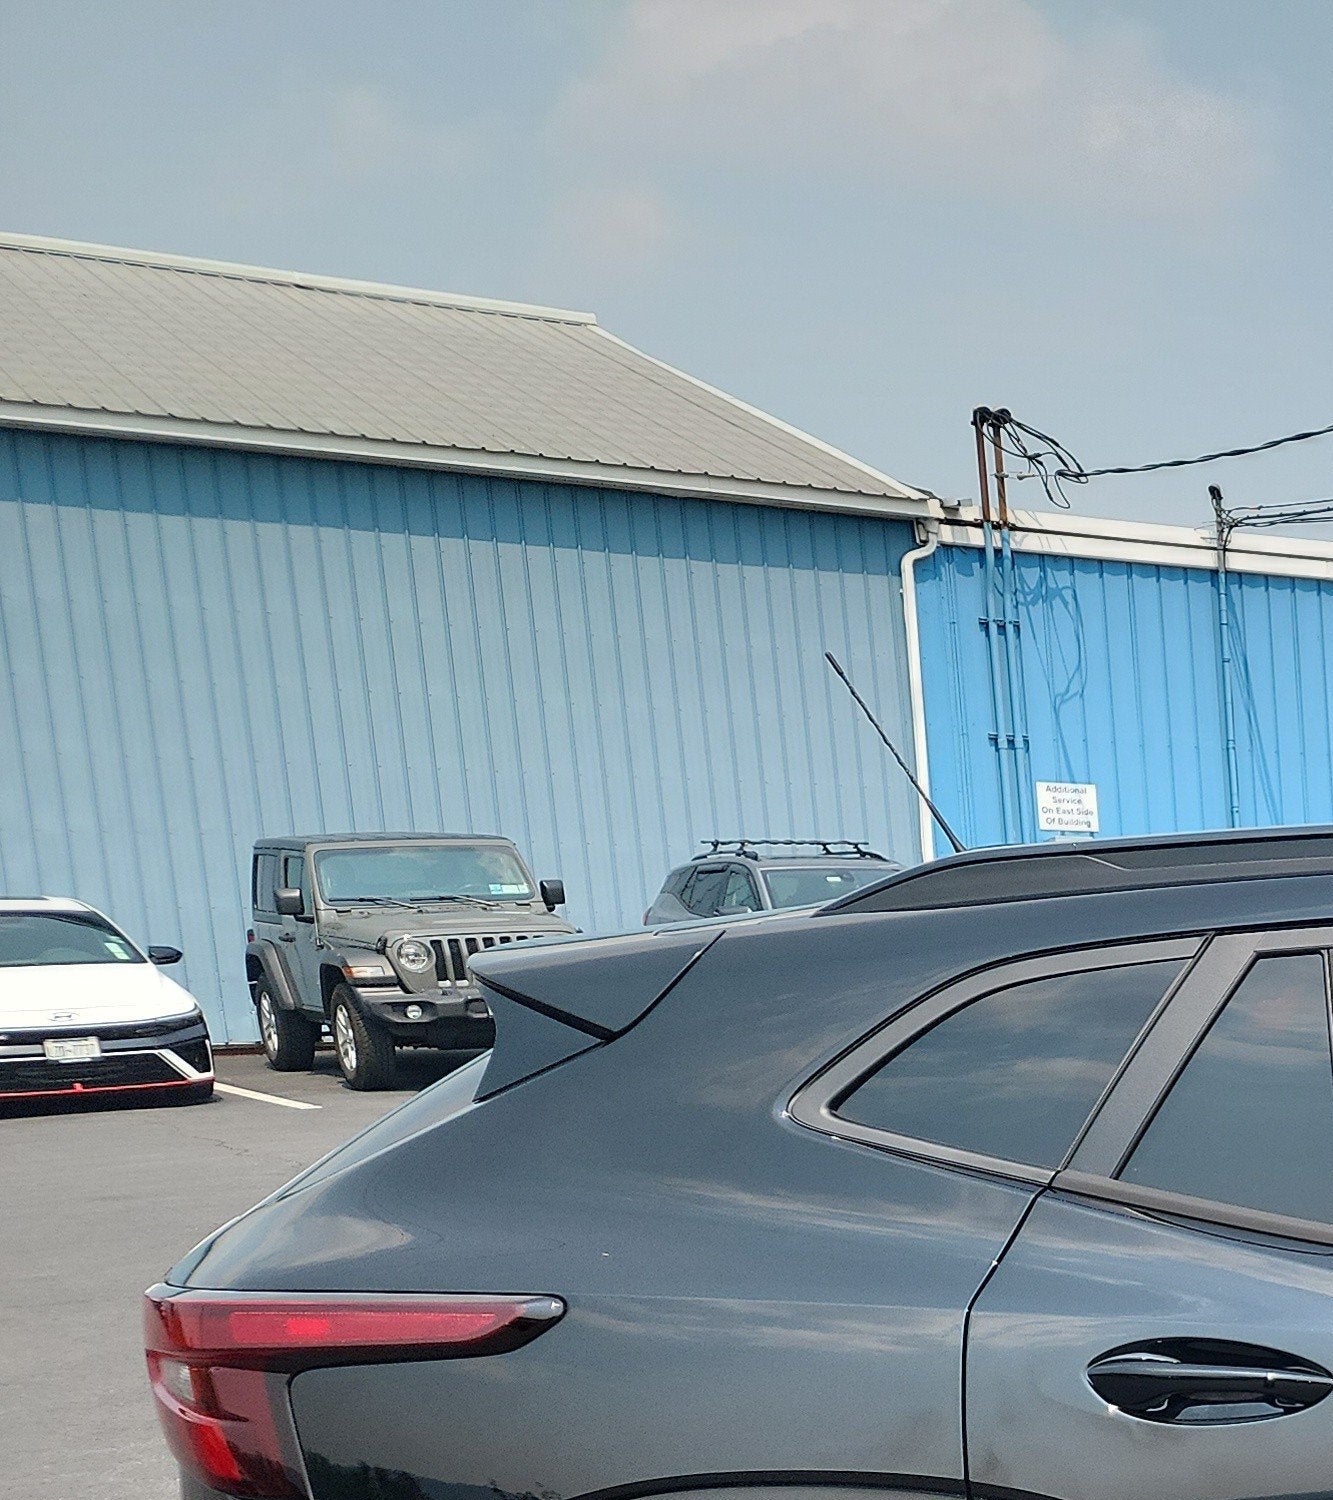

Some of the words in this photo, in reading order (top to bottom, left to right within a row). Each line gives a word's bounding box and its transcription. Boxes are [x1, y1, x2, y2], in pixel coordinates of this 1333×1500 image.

[1045, 785, 1087, 795] Additional
[1052, 796, 1082, 805] Service
[1041, 806, 1054, 814] On
[1056, 807, 1074, 815] East
[1076, 808, 1093, 816] Side
[1045, 817, 1056, 825] Of
[1058, 818, 1091, 828] Building
